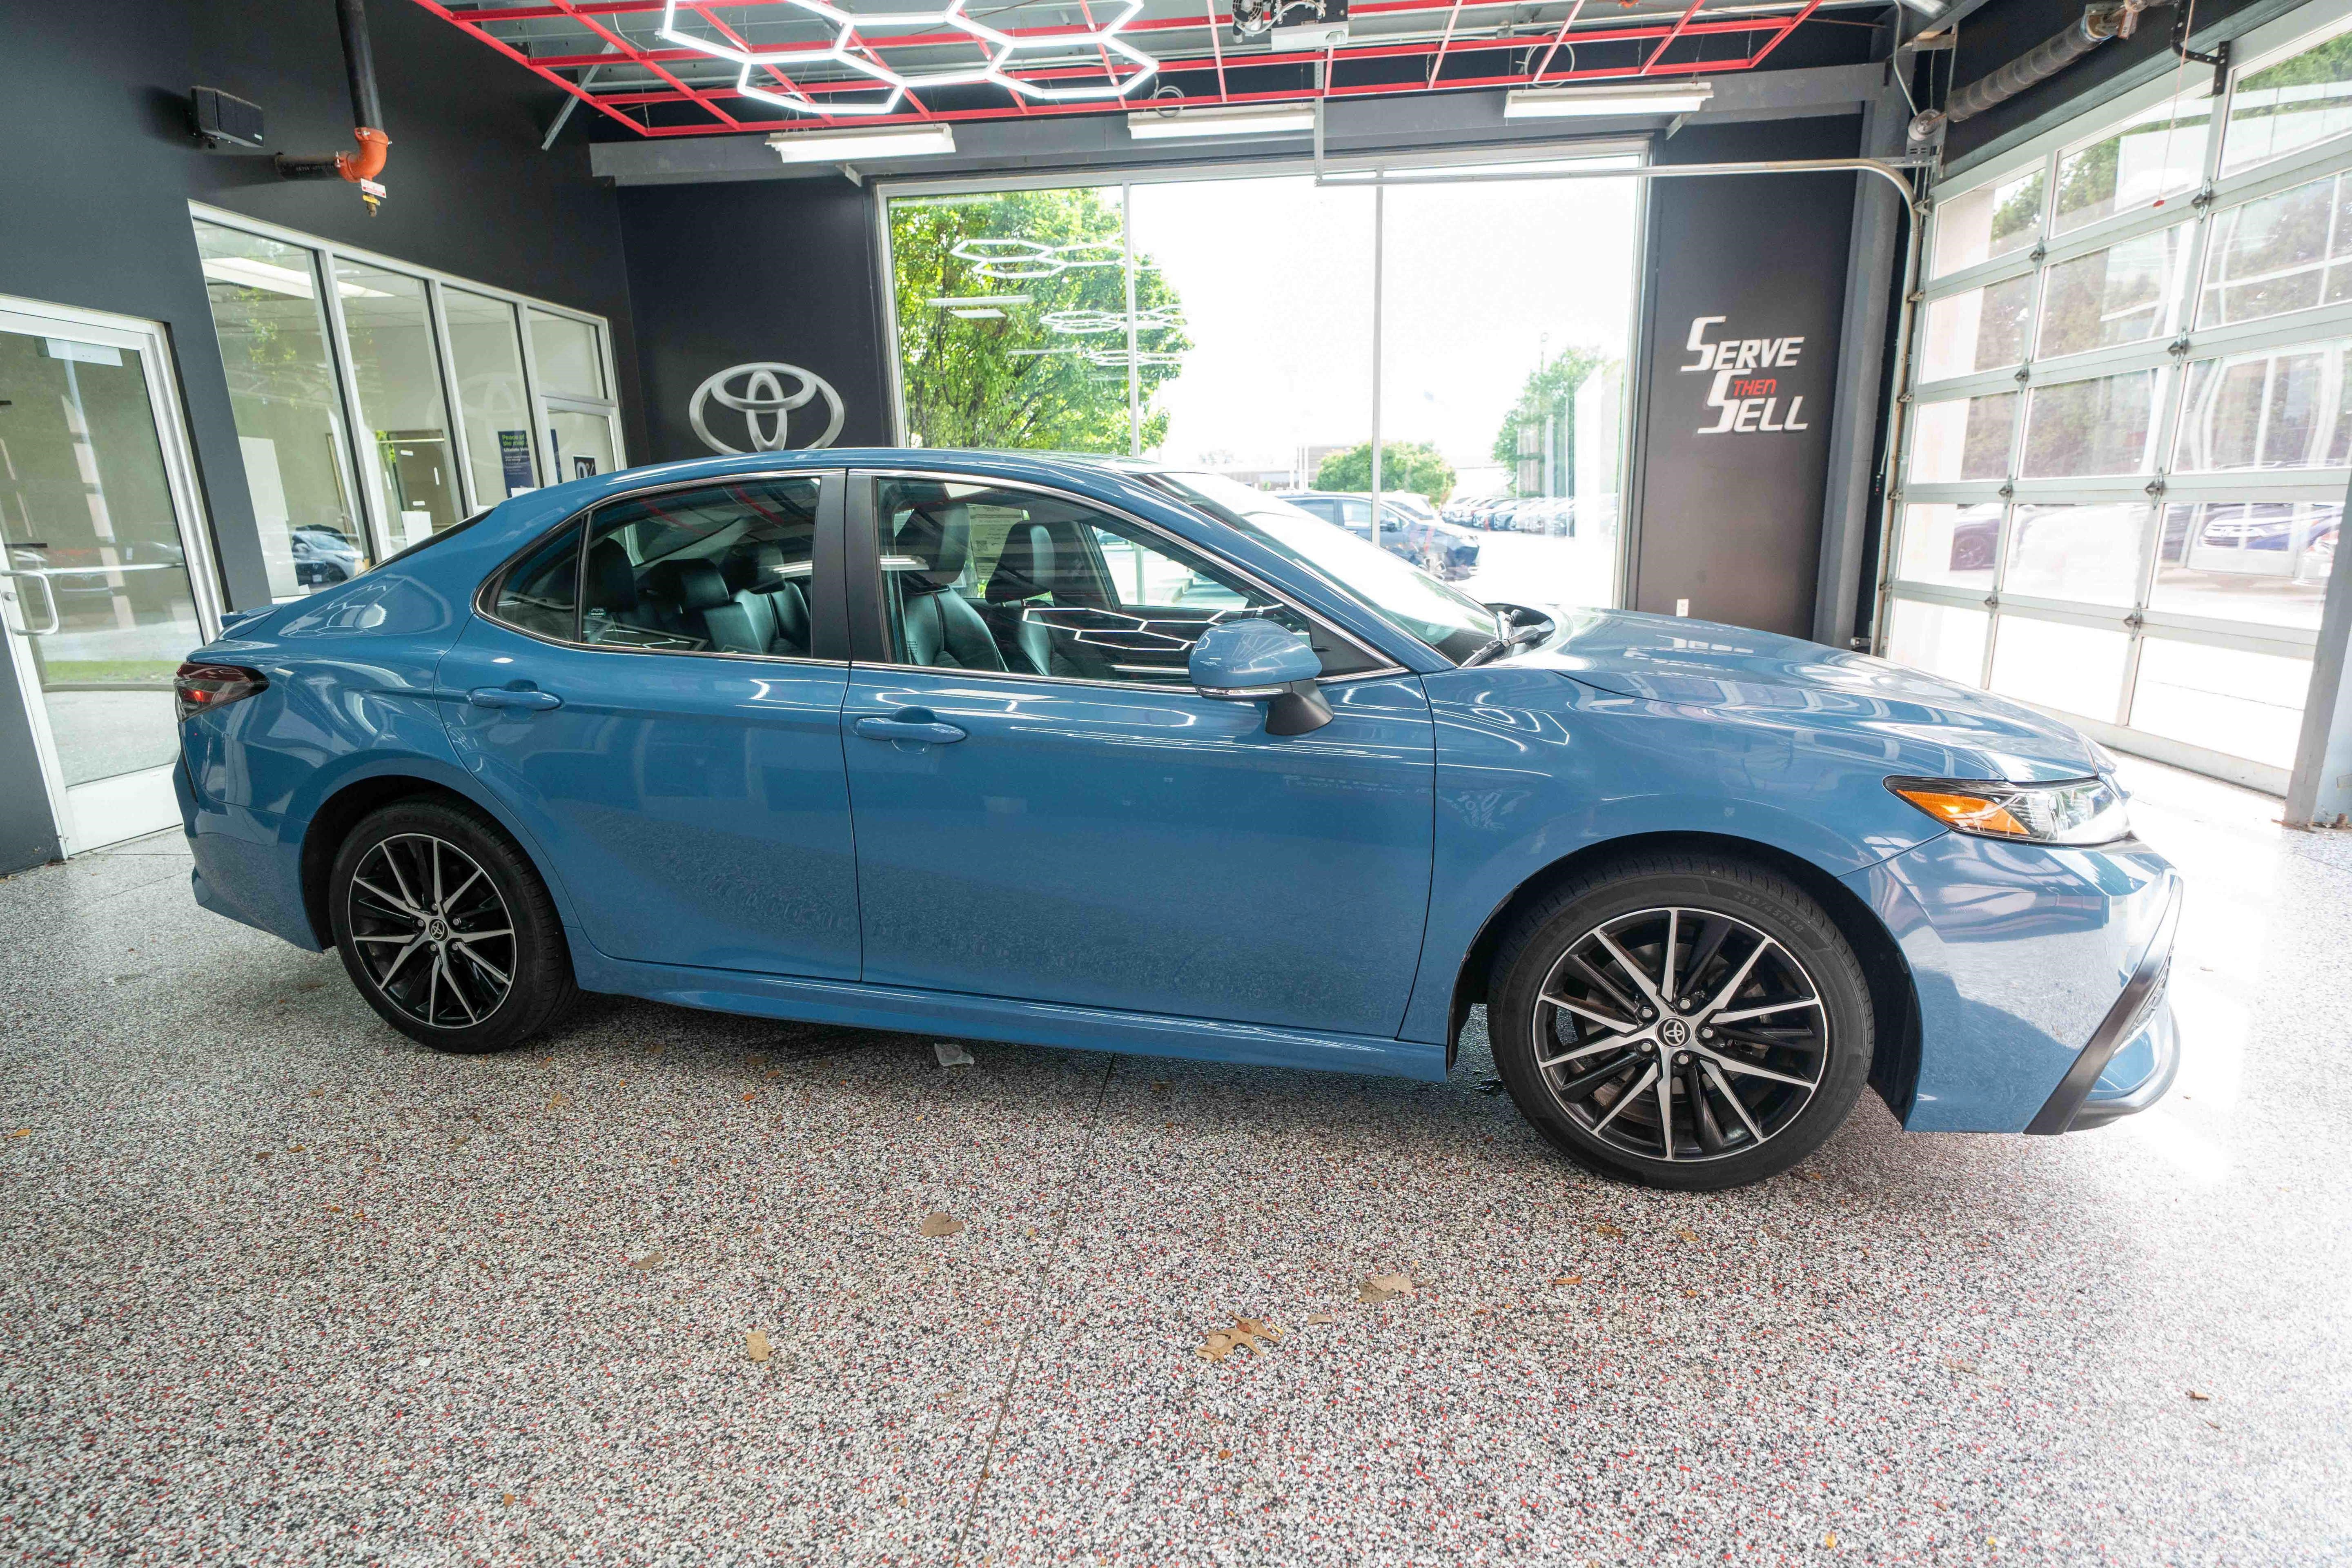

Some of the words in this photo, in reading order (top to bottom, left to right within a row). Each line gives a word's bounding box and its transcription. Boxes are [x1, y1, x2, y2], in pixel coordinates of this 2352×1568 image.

[1680, 316, 1804, 372] SERVE
[1697, 368, 1809, 434] SELL
[1733, 379, 1777, 396] THEN
[1734, 891, 1804, 932] 235/45R18
